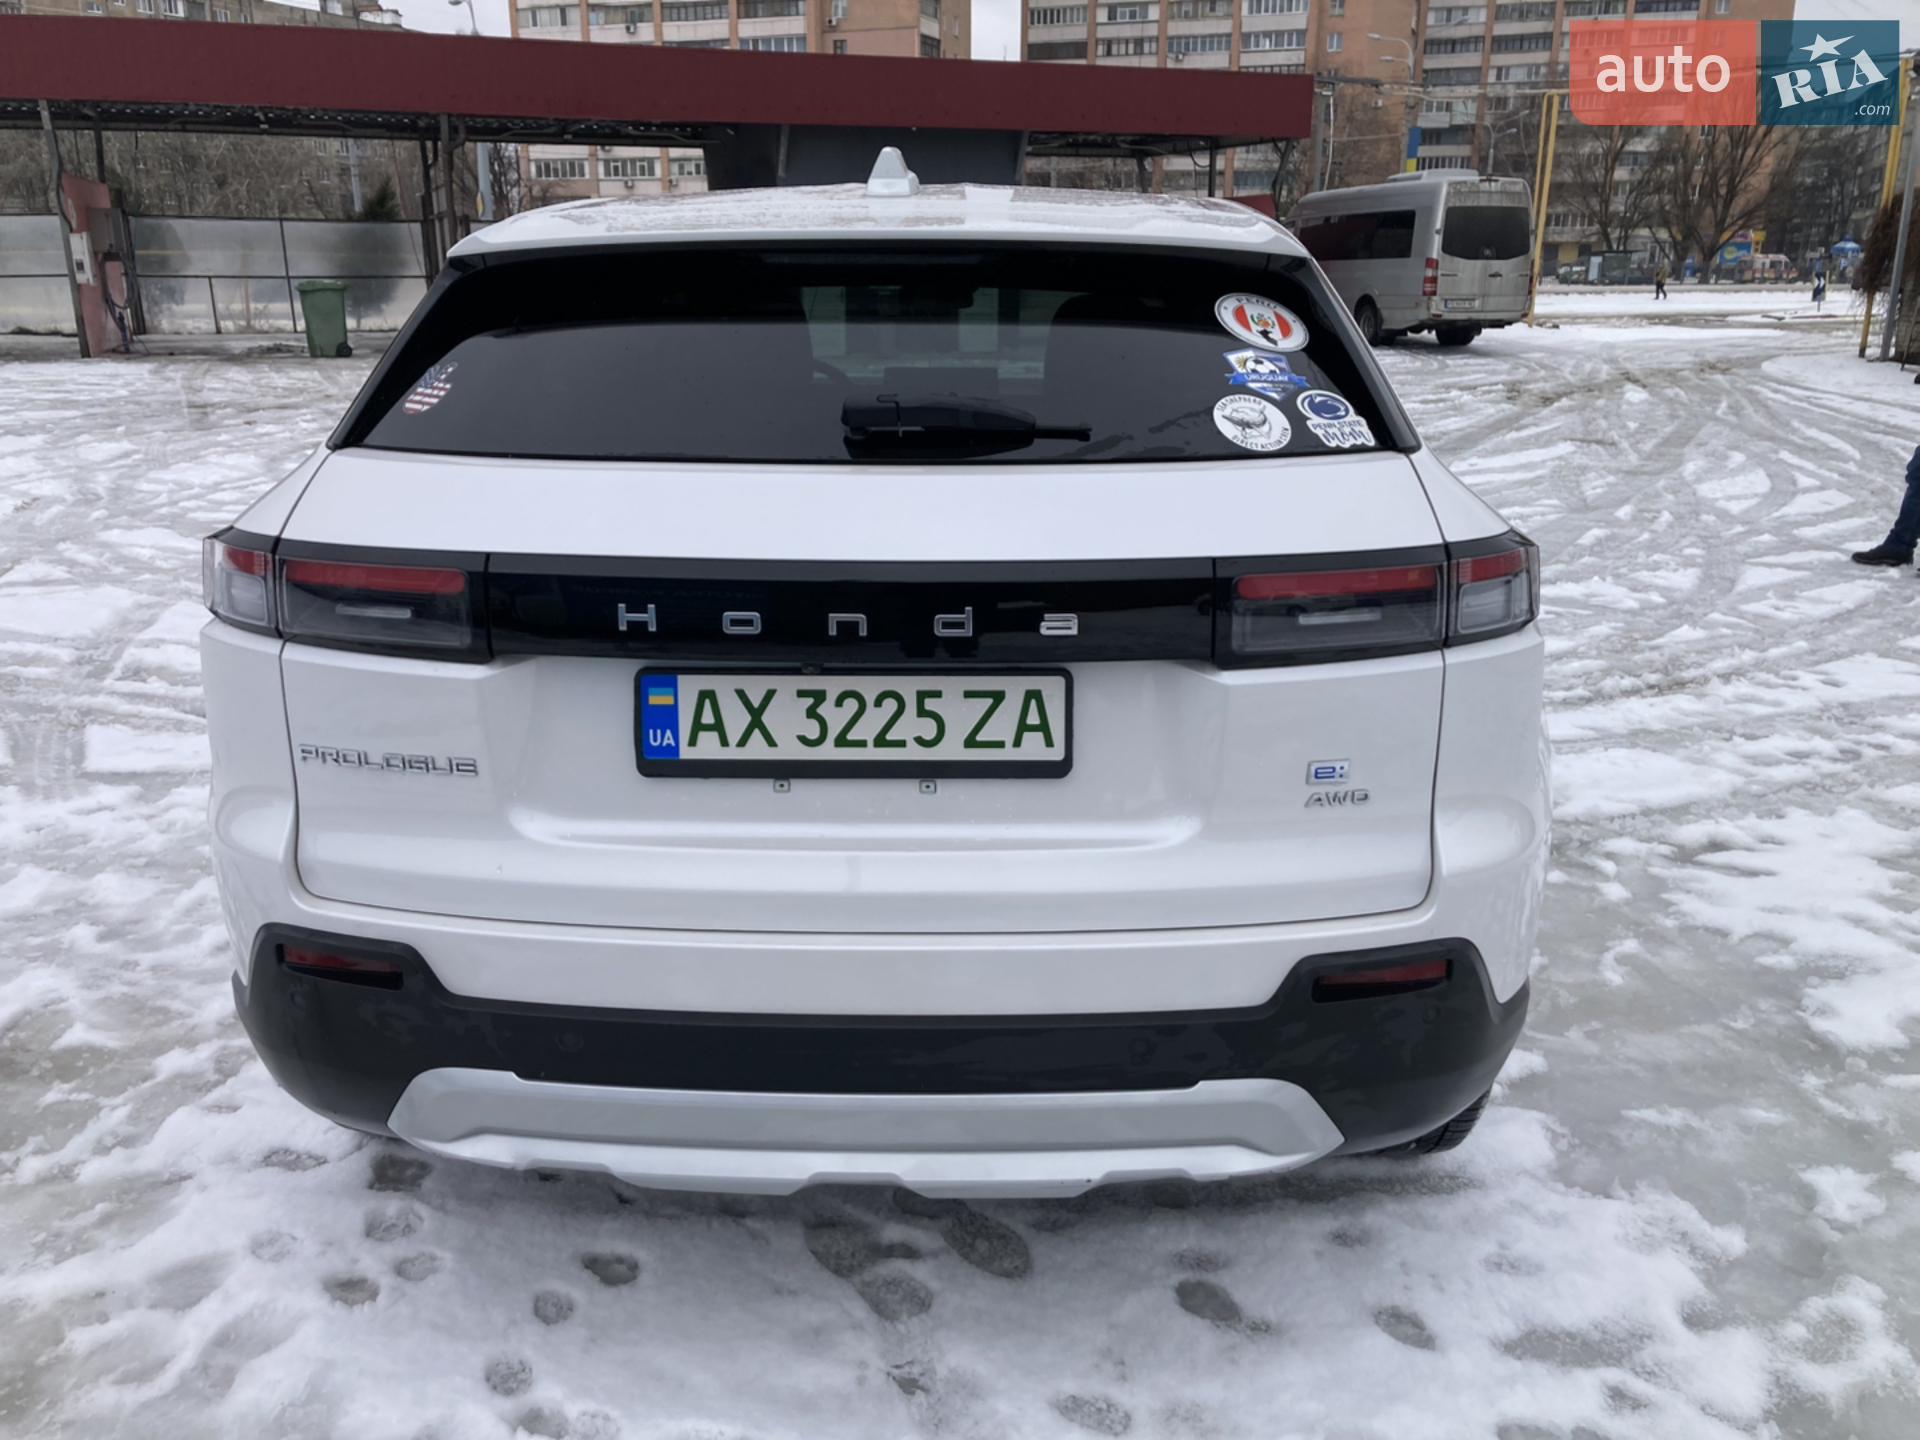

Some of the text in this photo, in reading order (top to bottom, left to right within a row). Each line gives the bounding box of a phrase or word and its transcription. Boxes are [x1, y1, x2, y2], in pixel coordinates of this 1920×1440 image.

[1311, 420, 1364, 430] PENN STATE
[687, 689, 1055, 749] AX 3225 ZA
[649, 729, 675, 747] UA
[299, 743, 479, 777] PROLOGUE
[1304, 788, 1370, 808] AWD
